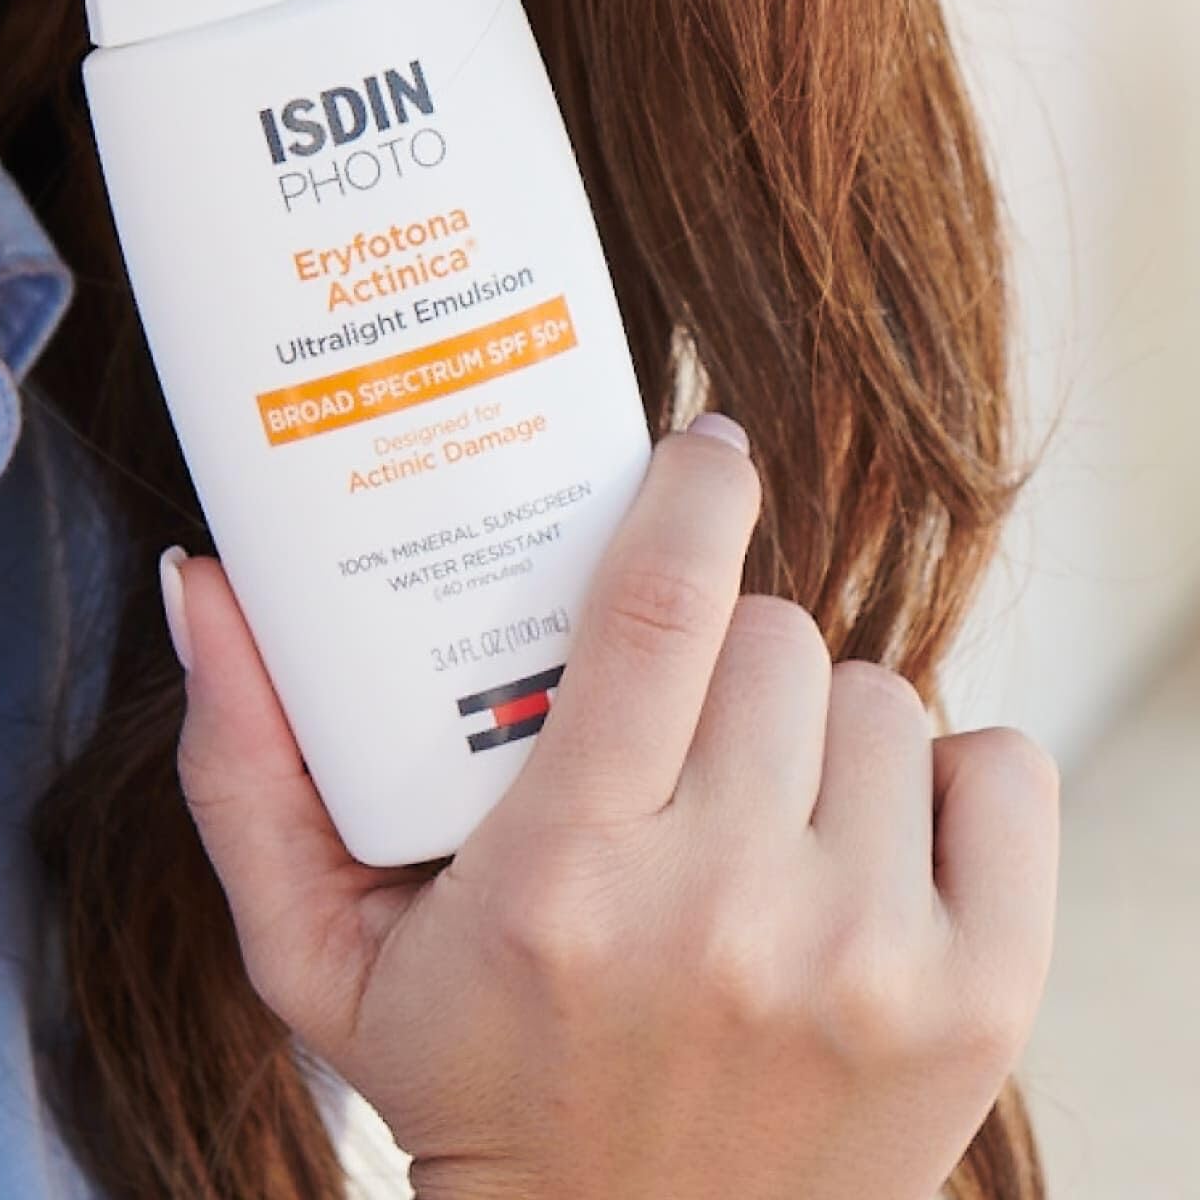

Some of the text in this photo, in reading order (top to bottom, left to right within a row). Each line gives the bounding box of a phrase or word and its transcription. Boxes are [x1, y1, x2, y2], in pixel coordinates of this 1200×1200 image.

[259, 60, 434, 164] ISDIN
[279, 128, 446, 213] PHOTO
[293, 208, 470, 281] Eryfotona
[276, 267, 534, 365] Ultralight Emulsion
[267, 319, 569, 433] BROAD SPECTRUM SPF 50+
[350, 416, 546, 493] Actinic Damage
[373, 402, 502, 456] Designed for
[338, 481, 592, 576] 100% MINERAL SUNSCREEN
[388, 524, 562, 592] WATER RESISTANT
